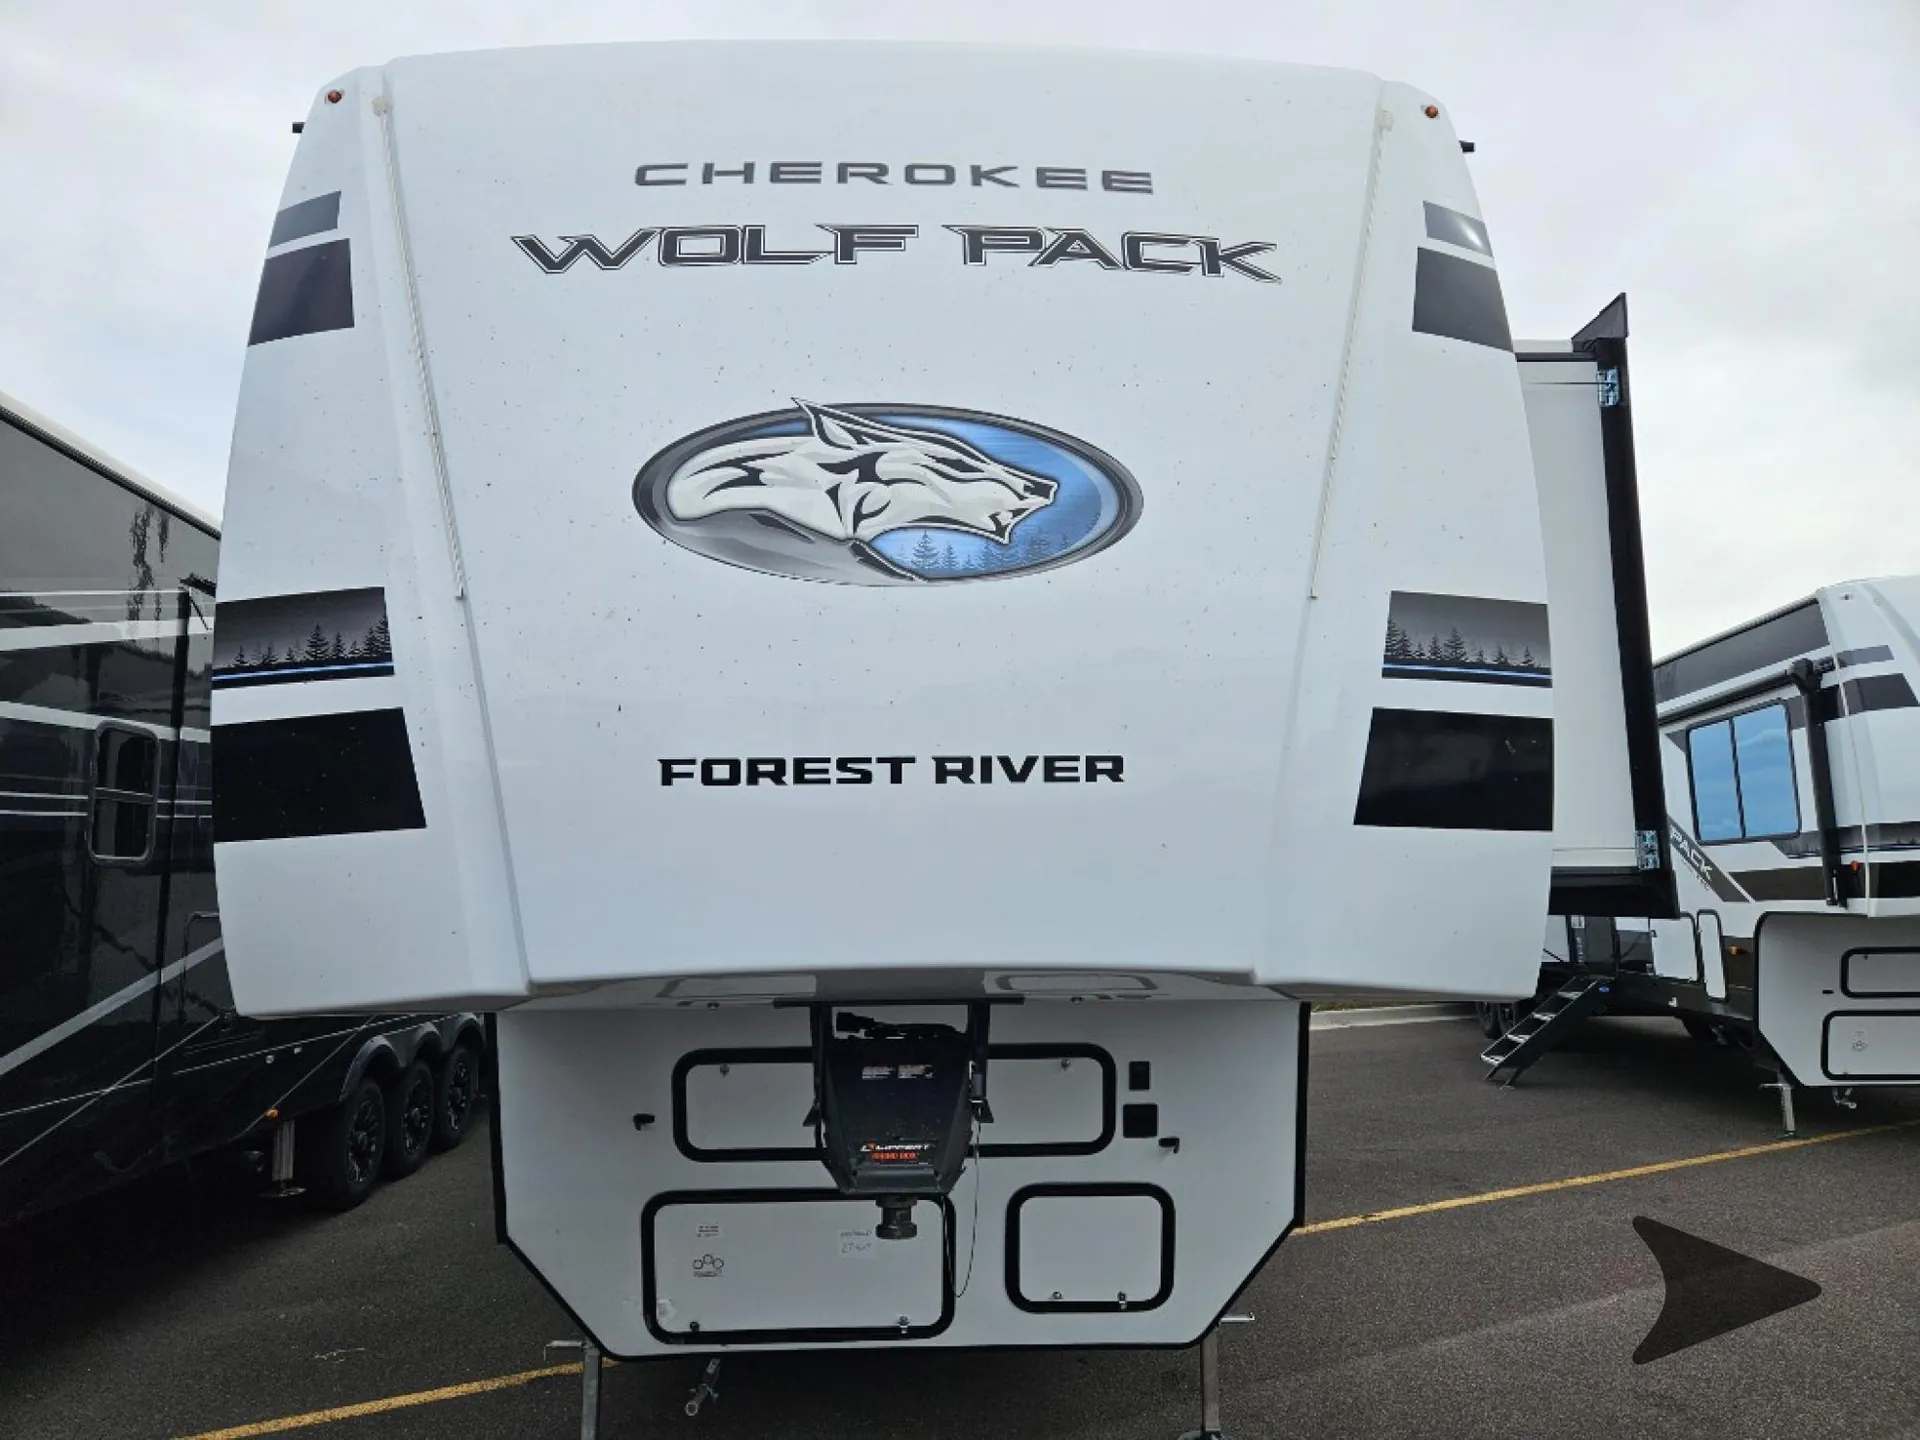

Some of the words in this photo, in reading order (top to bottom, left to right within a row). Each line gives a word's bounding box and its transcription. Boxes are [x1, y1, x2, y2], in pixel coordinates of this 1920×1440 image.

[634, 161, 1154, 194] CHEROKEE
[511, 224, 919, 275] WOLF
[942, 224, 1282, 284] PACK
[658, 756, 916, 787] FOREST
[932, 754, 1125, 785] RIVER
